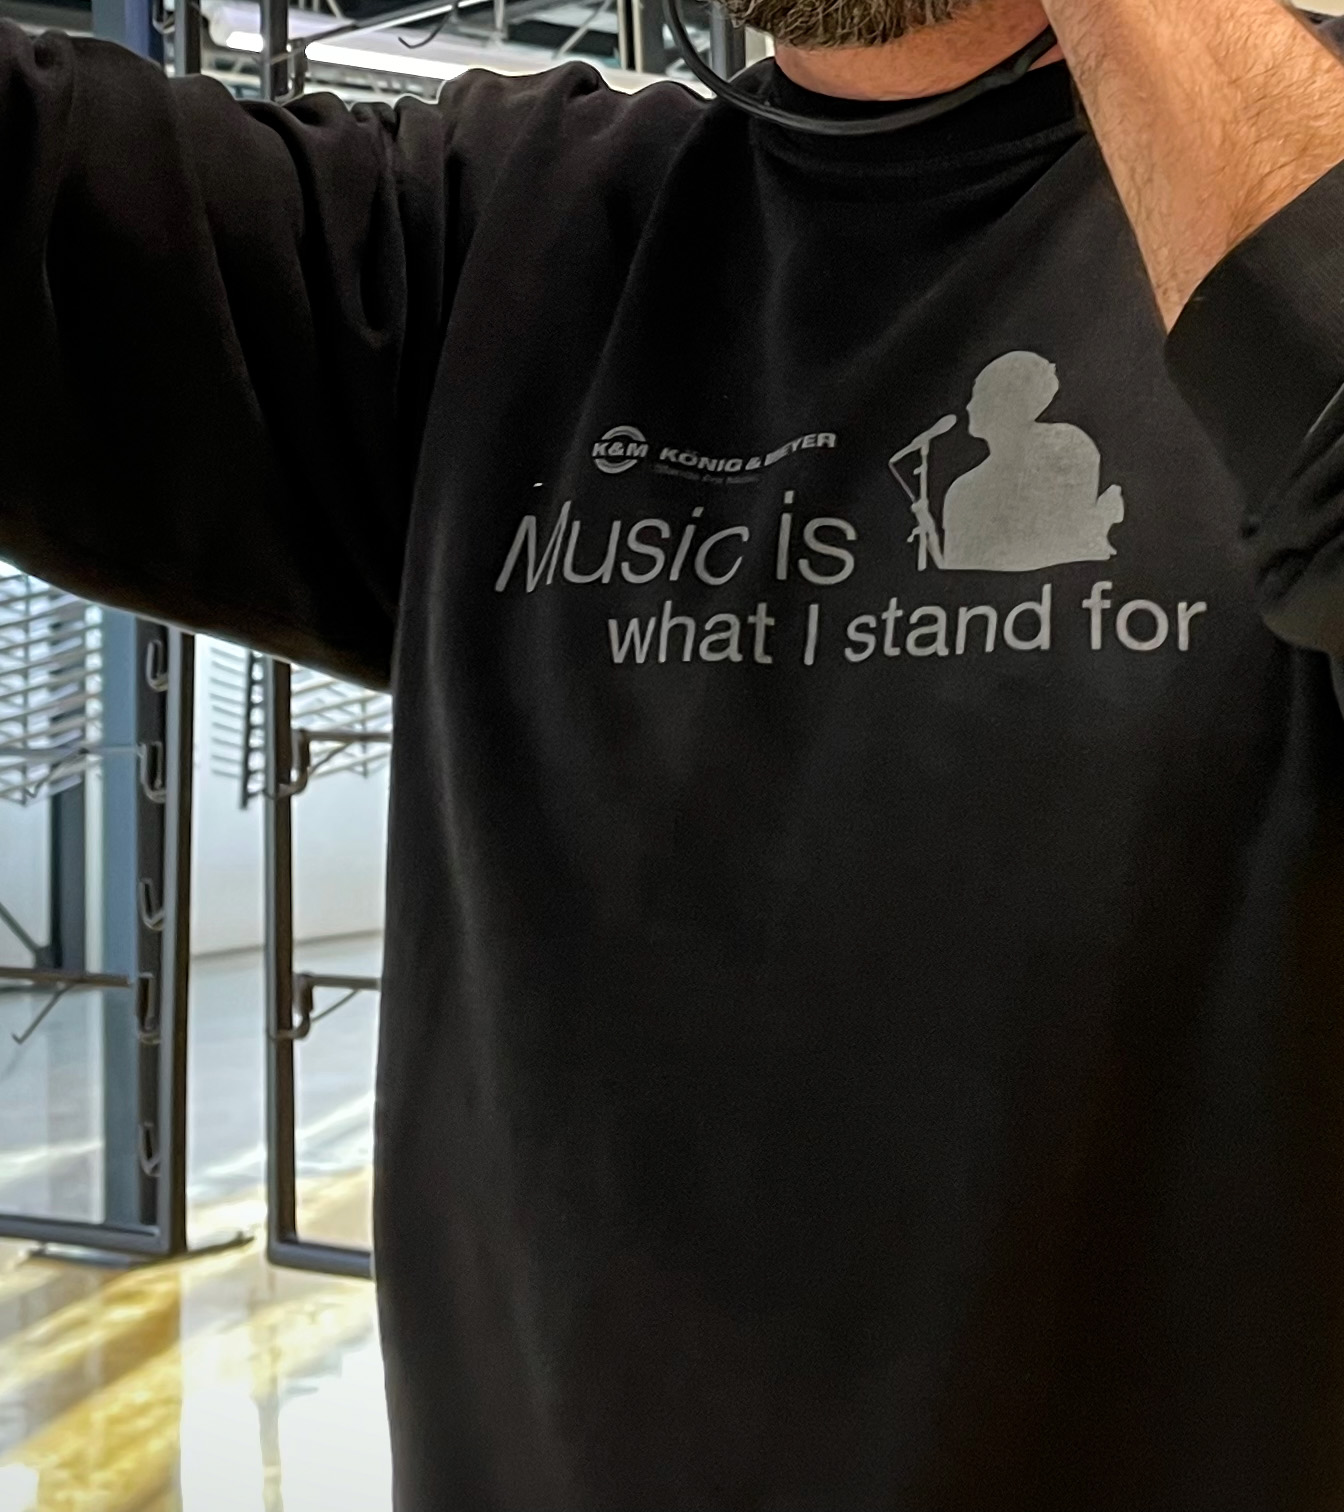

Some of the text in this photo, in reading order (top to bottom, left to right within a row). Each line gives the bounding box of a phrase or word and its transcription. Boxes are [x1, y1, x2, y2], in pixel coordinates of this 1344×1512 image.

[494, 489, 857, 593] Music is
[607, 580, 1208, 666] what I stand for
